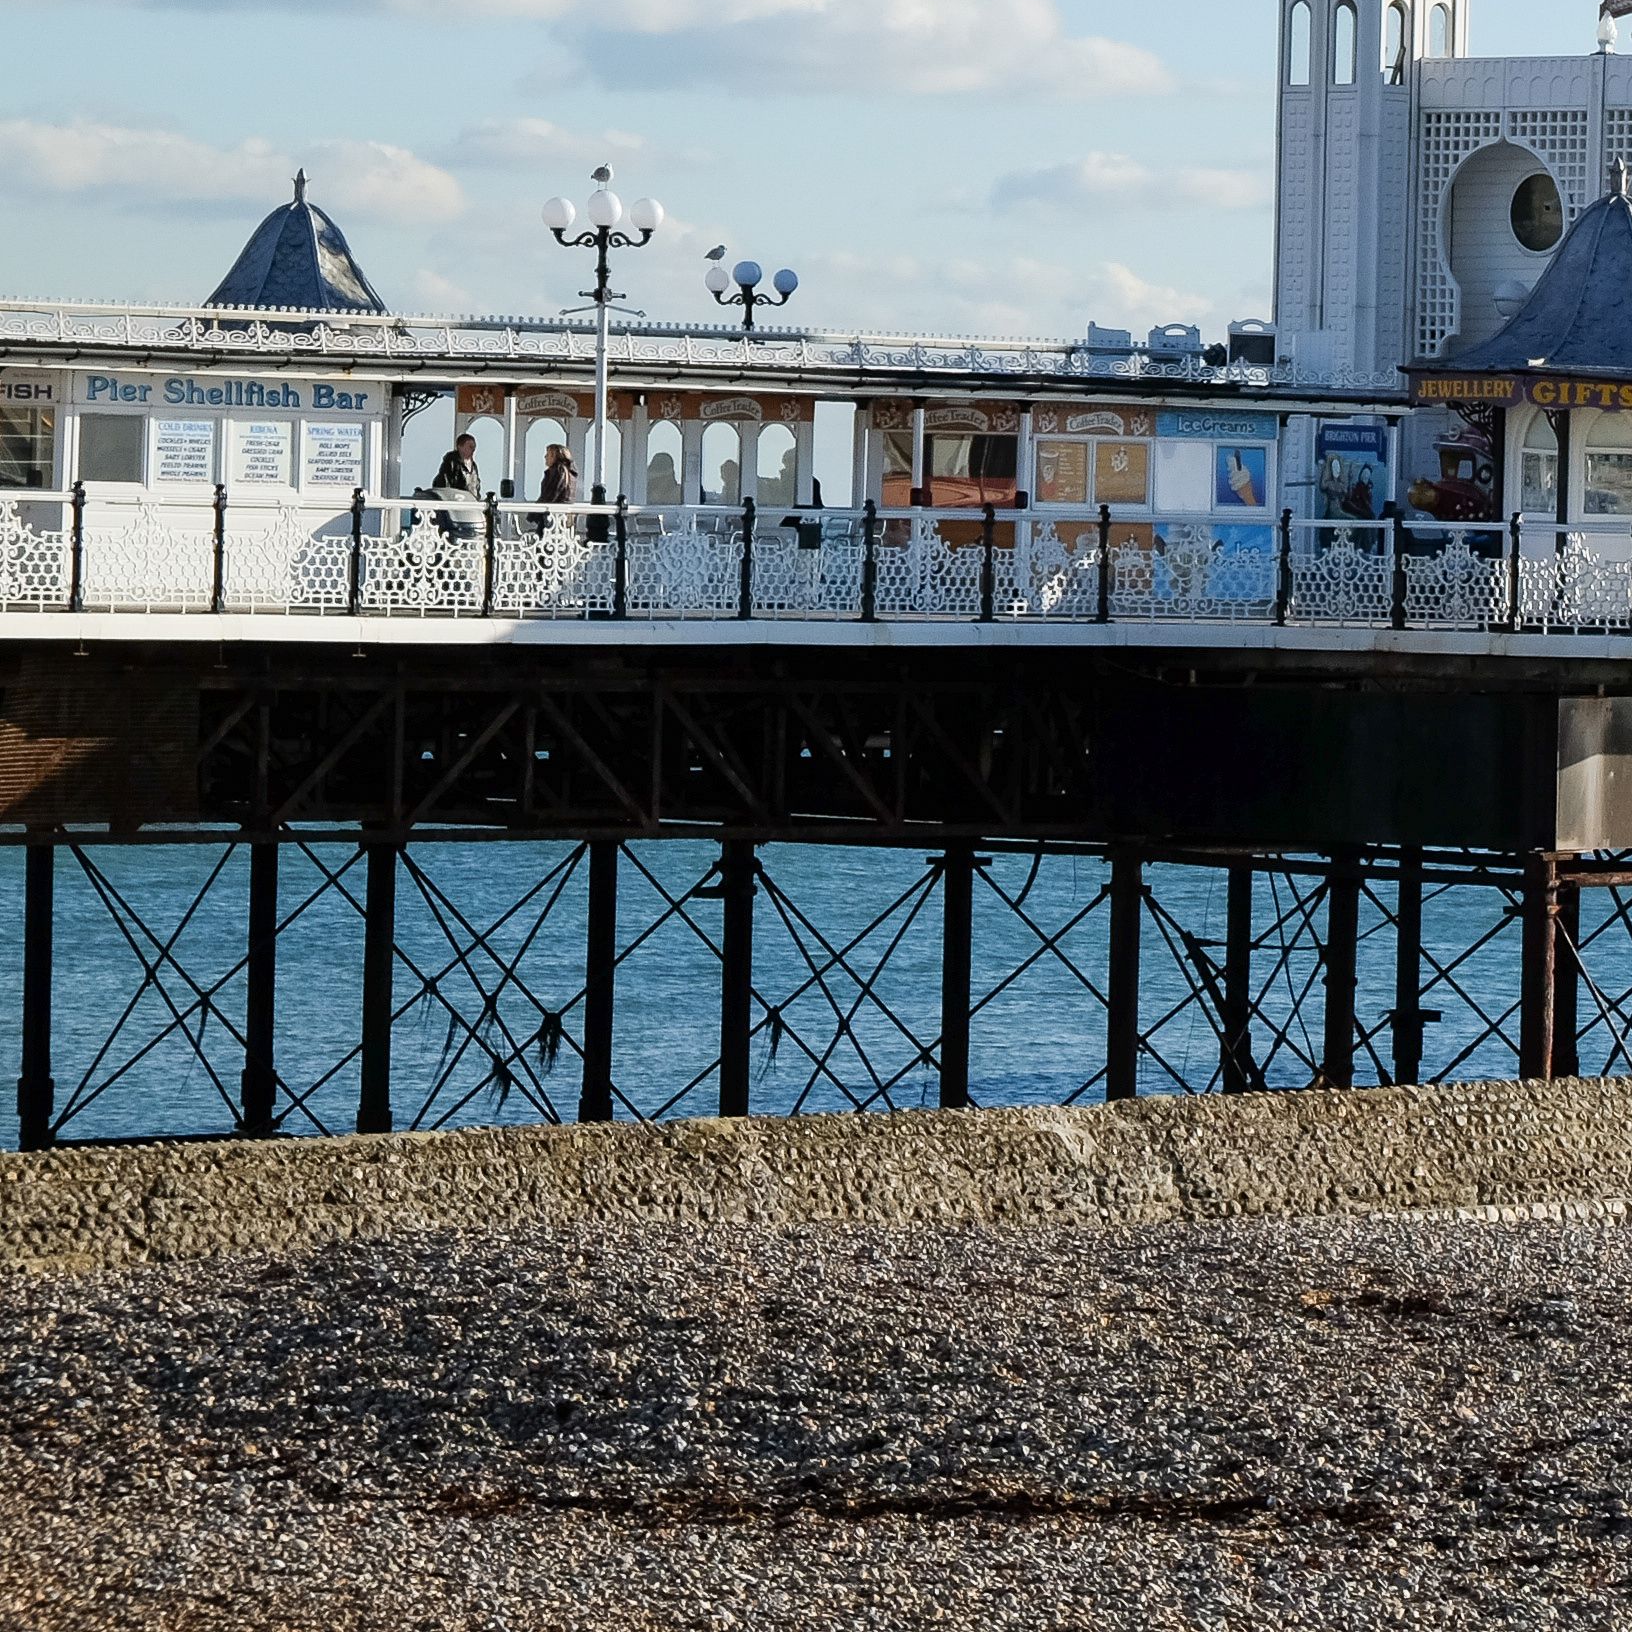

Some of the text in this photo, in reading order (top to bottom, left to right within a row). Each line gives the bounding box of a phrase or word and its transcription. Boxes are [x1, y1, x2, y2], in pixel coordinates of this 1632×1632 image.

[86, 375, 368, 410] Pier Shellfish Bar
[1418, 380, 1515, 398] JEWELLERY
